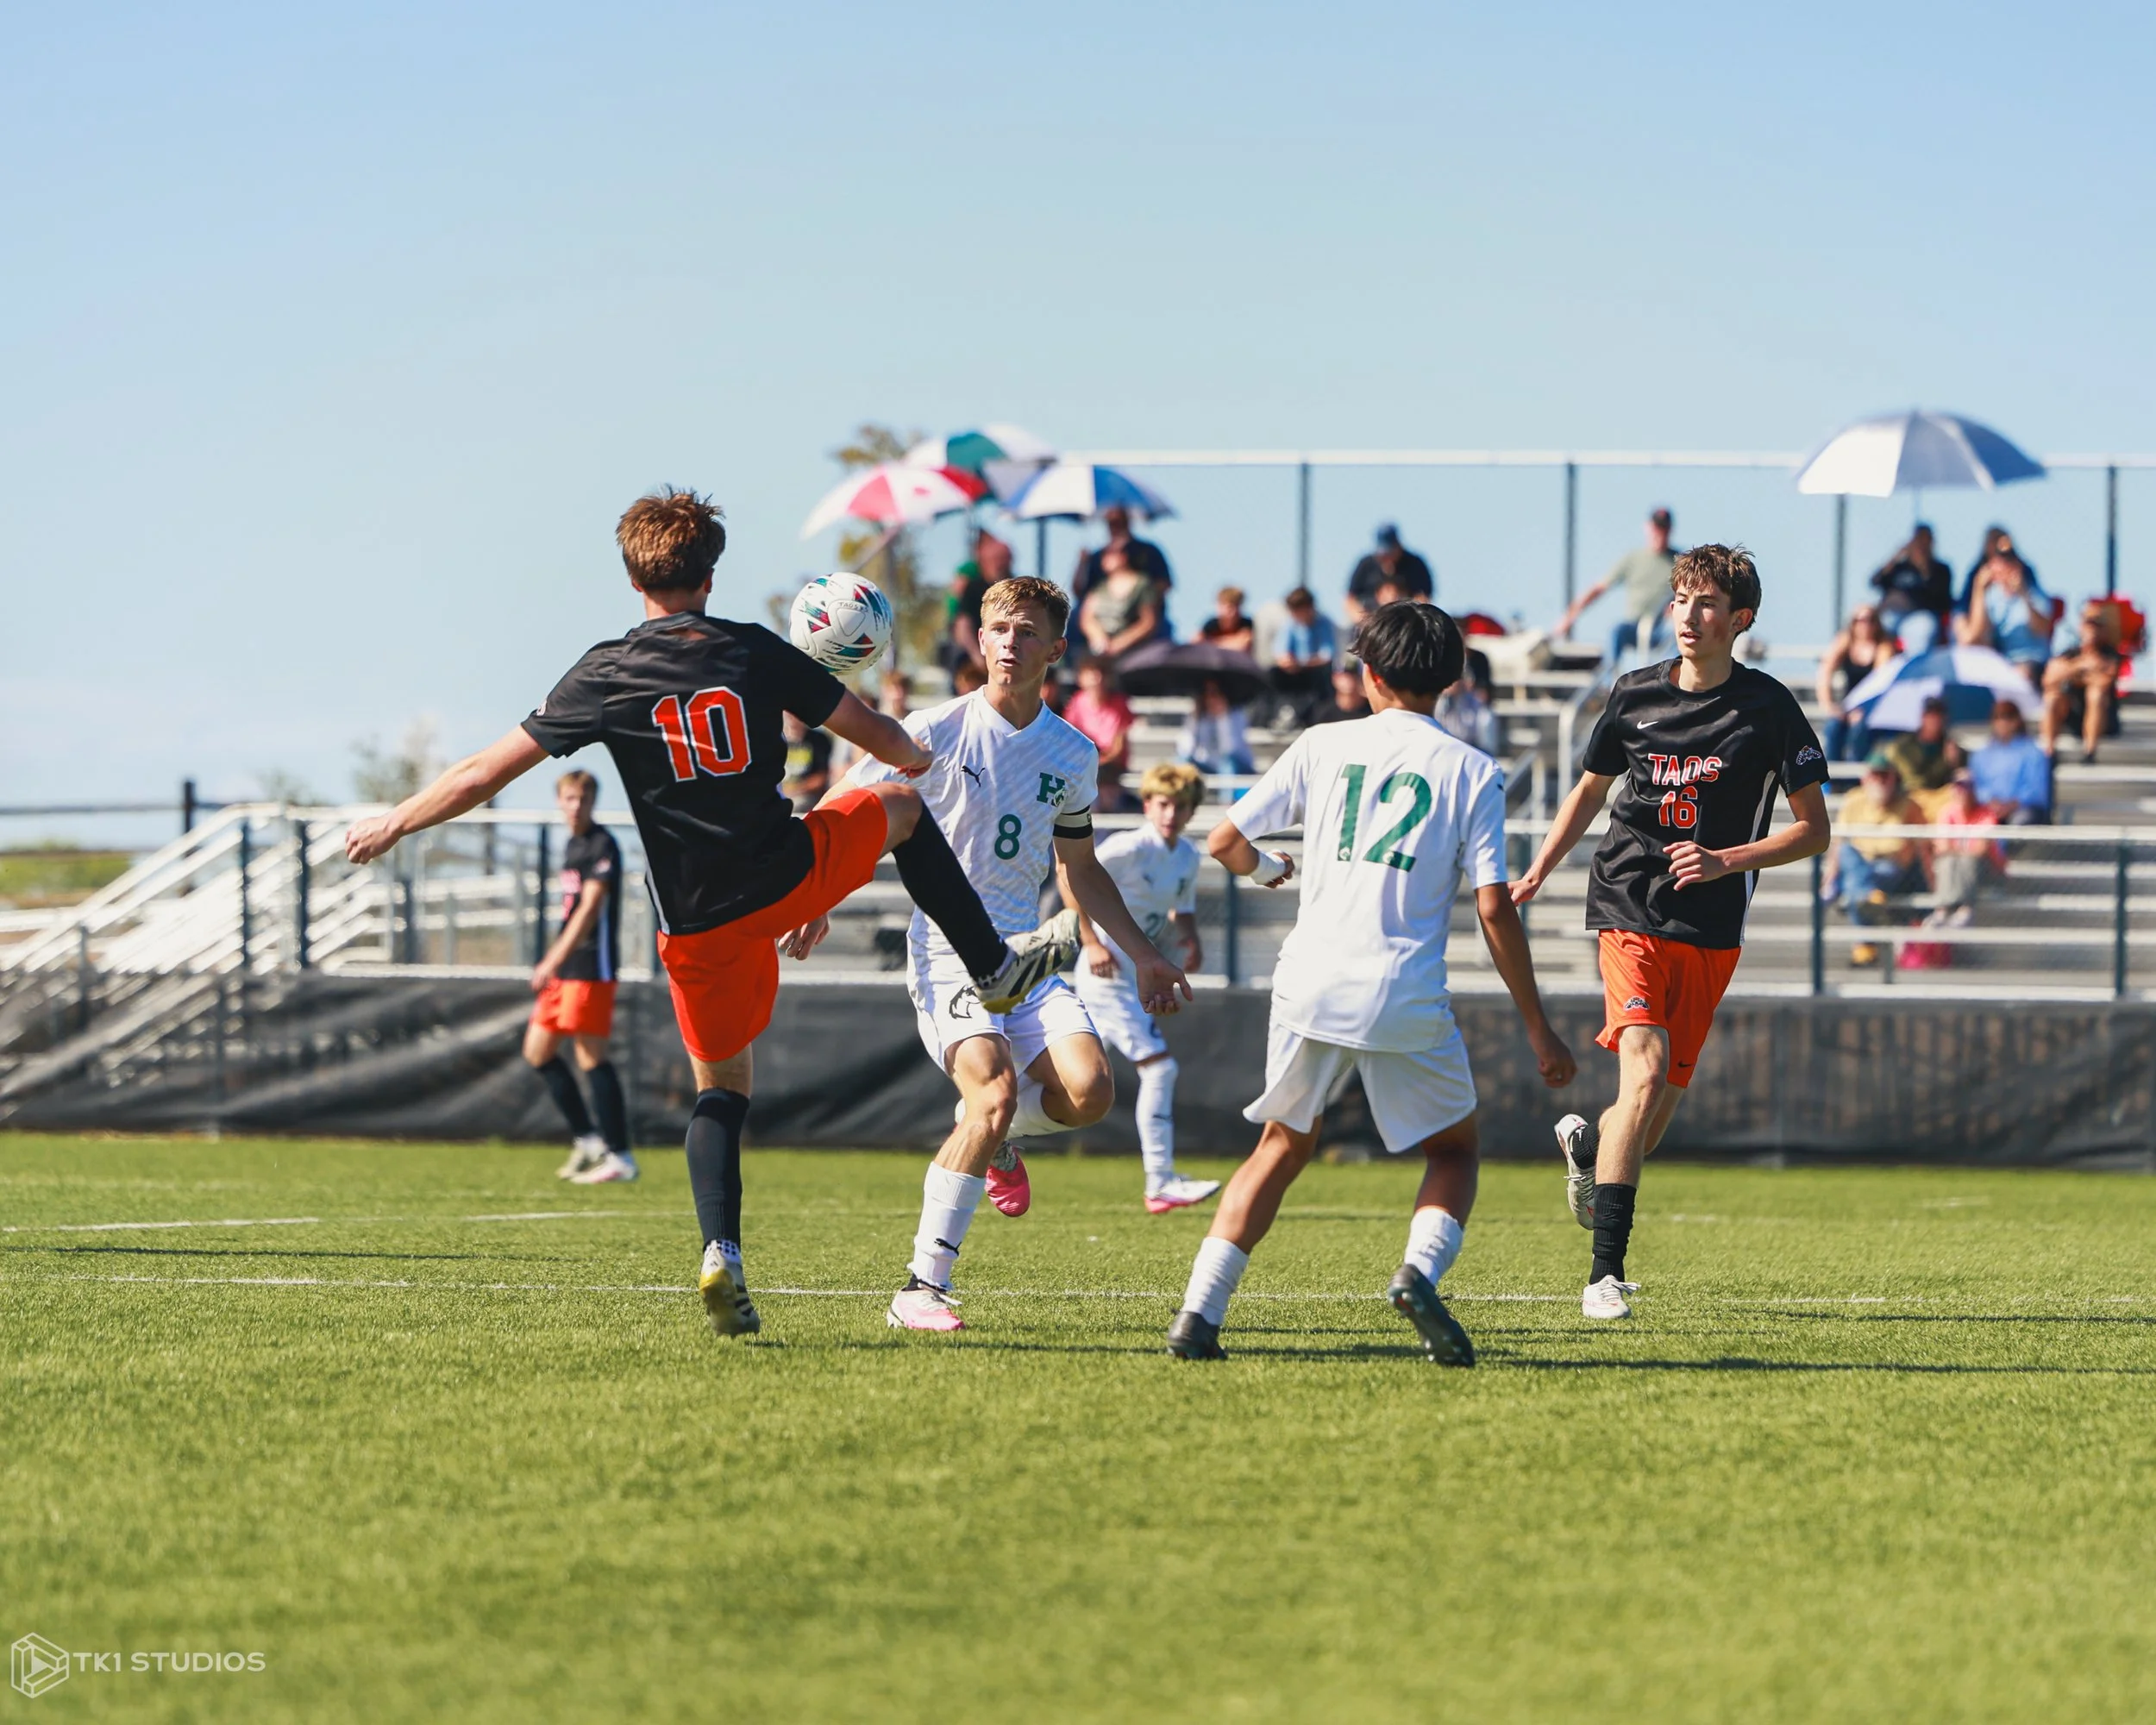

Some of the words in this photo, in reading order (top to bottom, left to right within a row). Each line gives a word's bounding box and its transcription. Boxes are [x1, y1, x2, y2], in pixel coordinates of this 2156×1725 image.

[837, 601, 859, 611] TAOS
[651, 686, 752, 782] 10
[1648, 753, 1722, 786] TAOS
[1337, 763, 1432, 873] 12
[1658, 786, 1697, 829] 16
[994, 814, 1022, 860] 8
